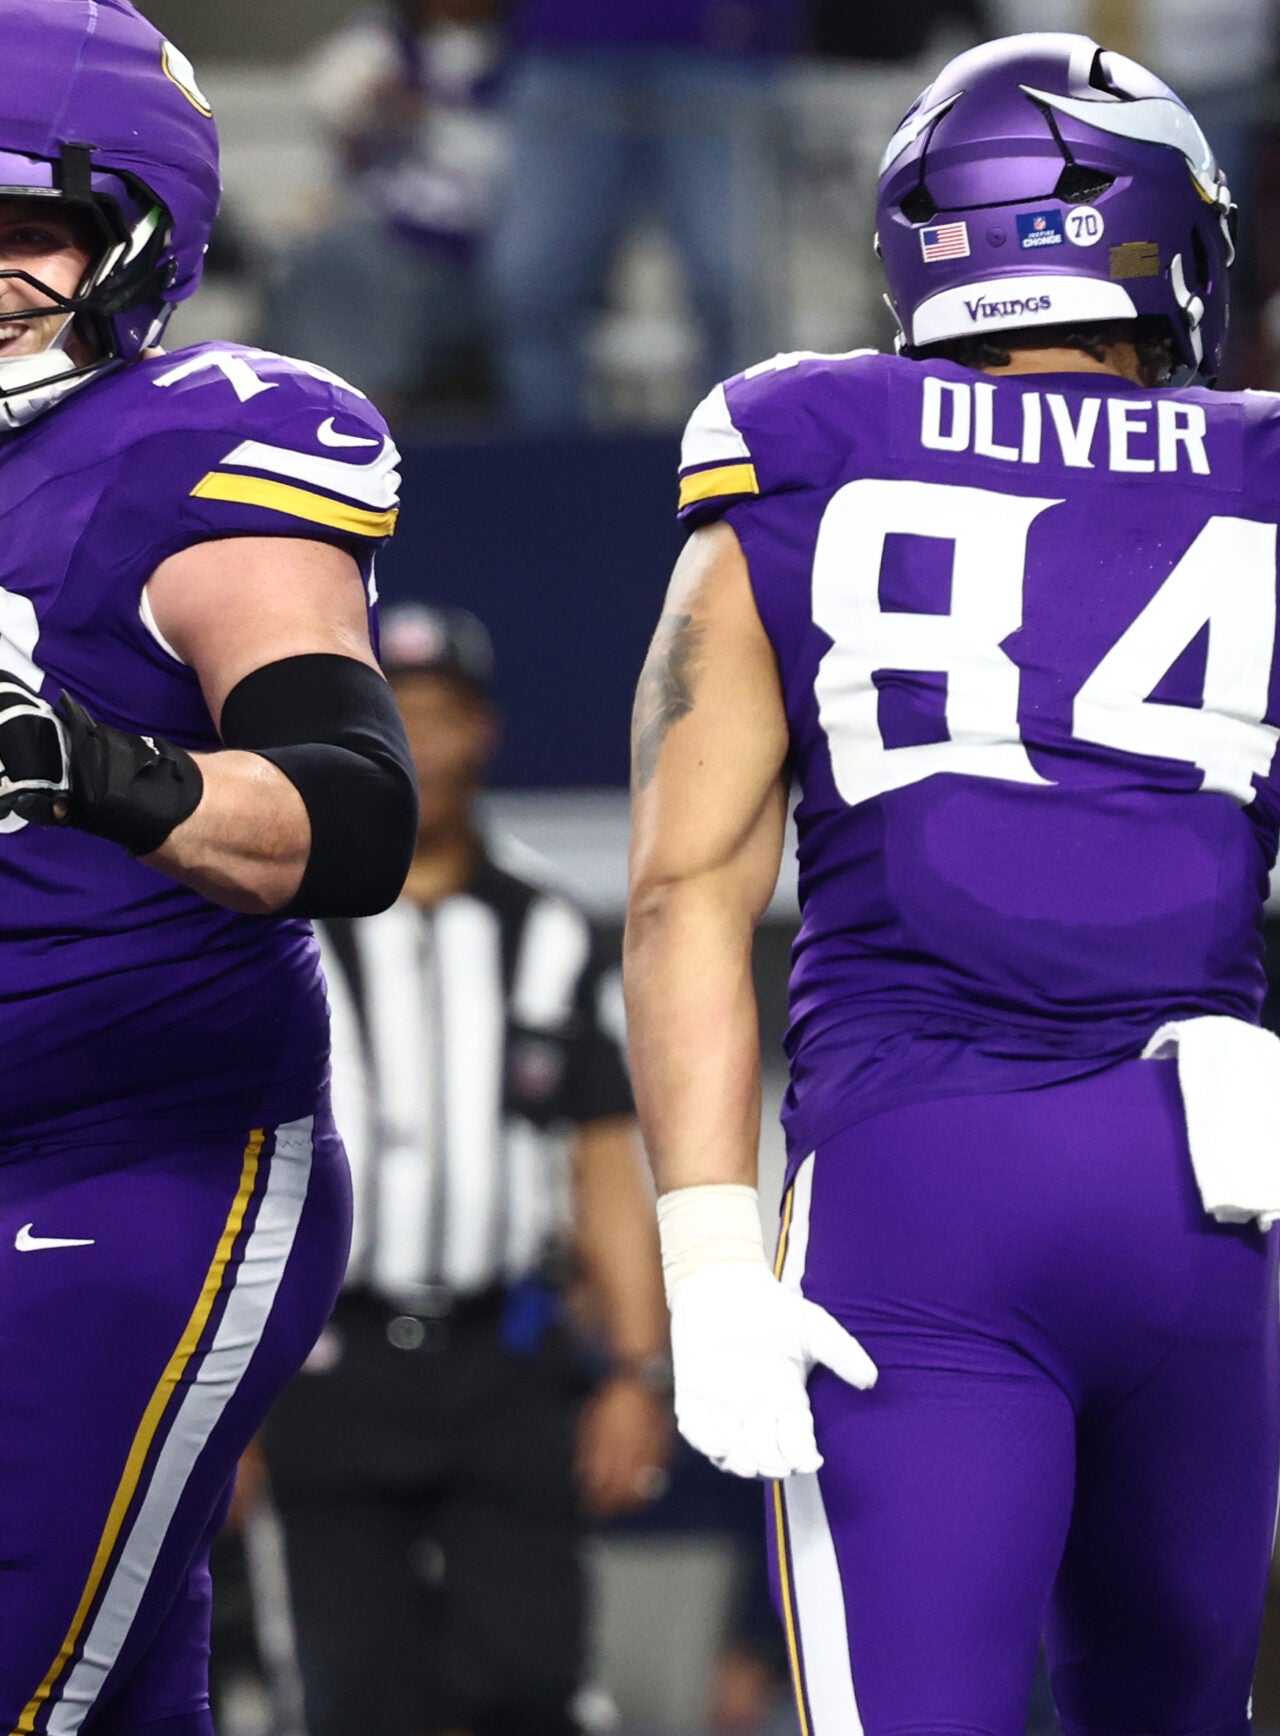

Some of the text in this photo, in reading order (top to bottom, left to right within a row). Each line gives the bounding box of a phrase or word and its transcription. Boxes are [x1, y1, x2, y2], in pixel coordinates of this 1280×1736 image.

[1071, 214, 1098, 239] 70
[1022, 234, 1062, 248] CHANGE
[963, 295, 1052, 322] VIKINGS
[921, 375, 1211, 476] OLIVER
